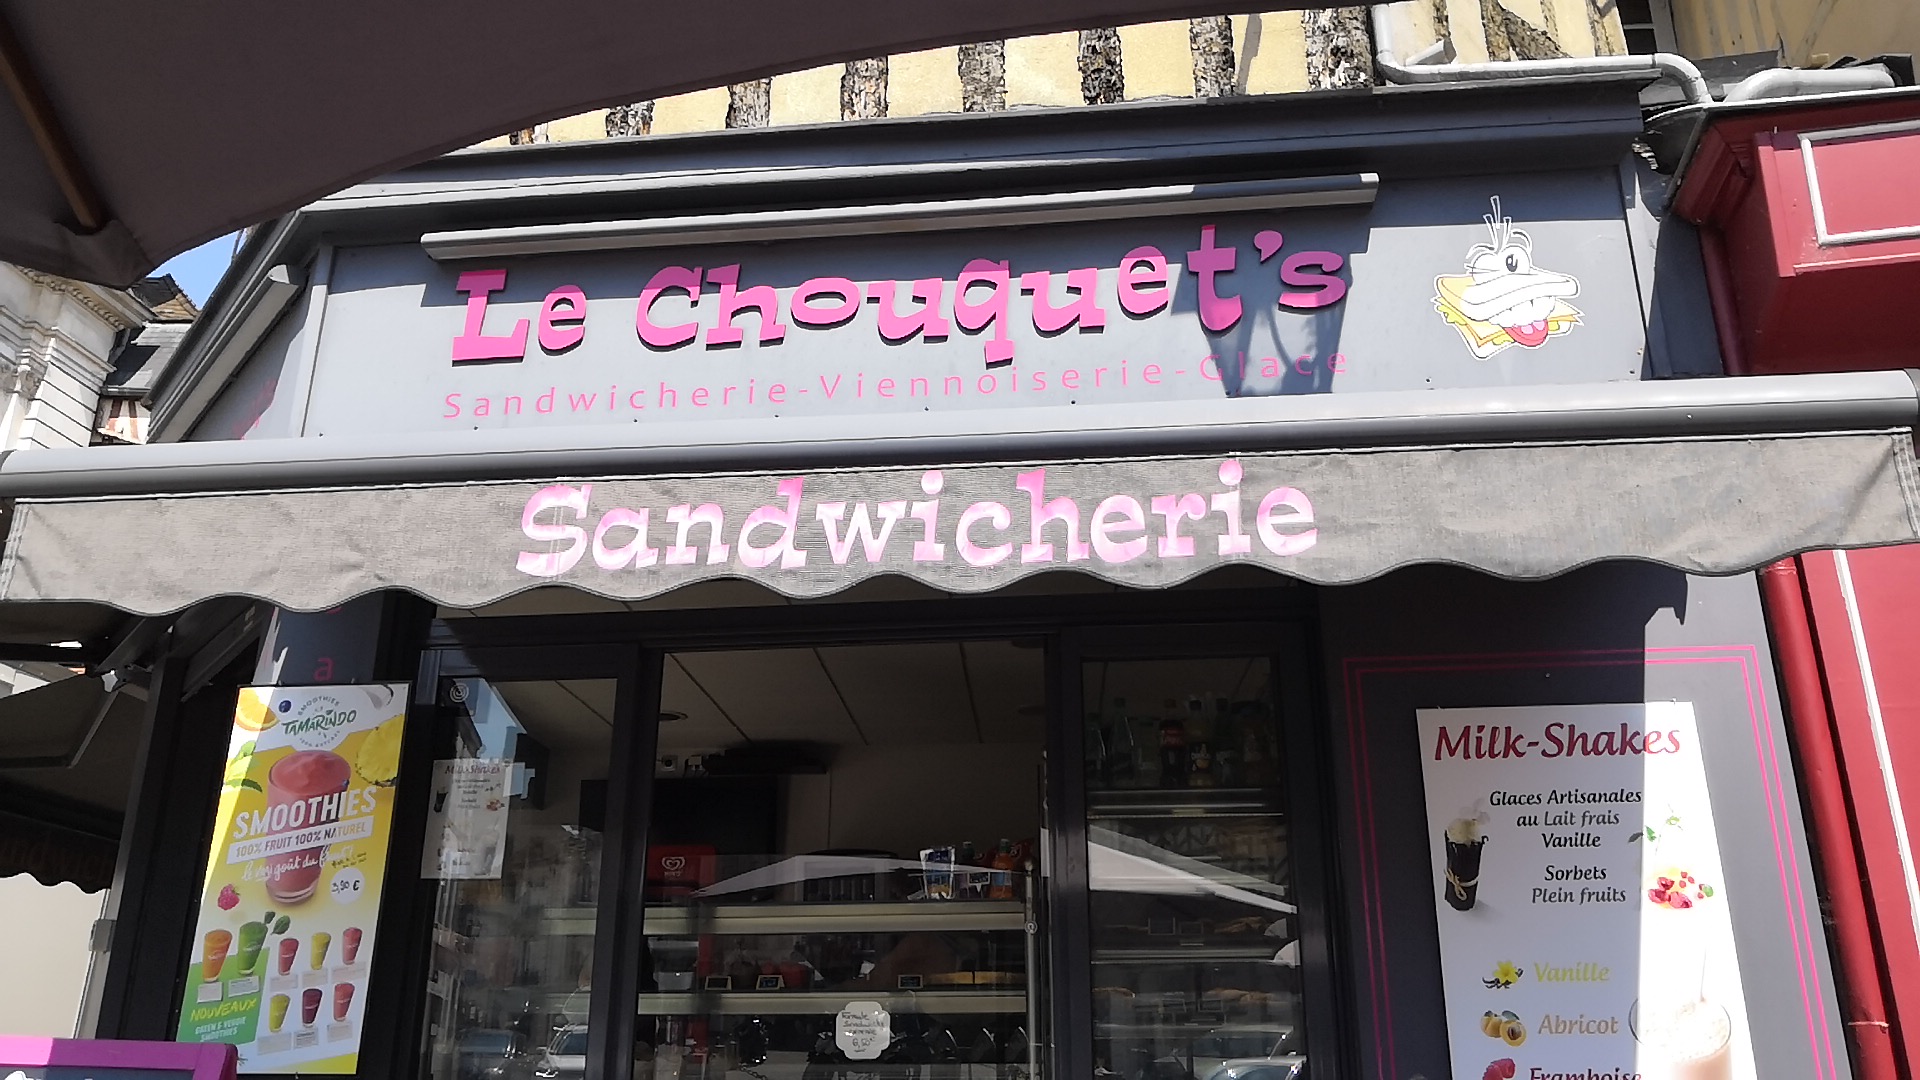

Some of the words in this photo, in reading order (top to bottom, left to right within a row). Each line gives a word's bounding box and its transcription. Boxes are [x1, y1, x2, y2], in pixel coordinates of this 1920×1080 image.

[452, 268, 588, 366] Le
[636, 224, 1348, 366] Chouquet's
[516, 457, 1318, 577] Sandwicherie
[1434, 722, 1682, 761] Milk-Shakes
[1489, 790, 1543, 807] Glaces
[1546, 788, 1643, 806] Artisanales
[233, 785, 377, 840] SMOOTHIES
[1516, 814, 1540, 828] au
[1544, 810, 1577, 827] Lait
[1581, 809, 1621, 829] frais
[236, 842, 263, 858] 100%
[264, 836, 293, 852] FRUIT
[295, 829, 322, 845] 100%
[323, 821, 366, 840] NATUREL
[1541, 832, 1602, 850] Vanille
[302, 854, 319, 869] du
[1544, 864, 1608, 882] Sorbets
[1531, 886, 1575, 904] Plein
[1579, 885, 1627, 906] fruits
[1533, 962, 1611, 983] Vanille
[189, 998, 257, 1022] NOUVEAUX
[1537, 1014, 1620, 1036] Abricot
